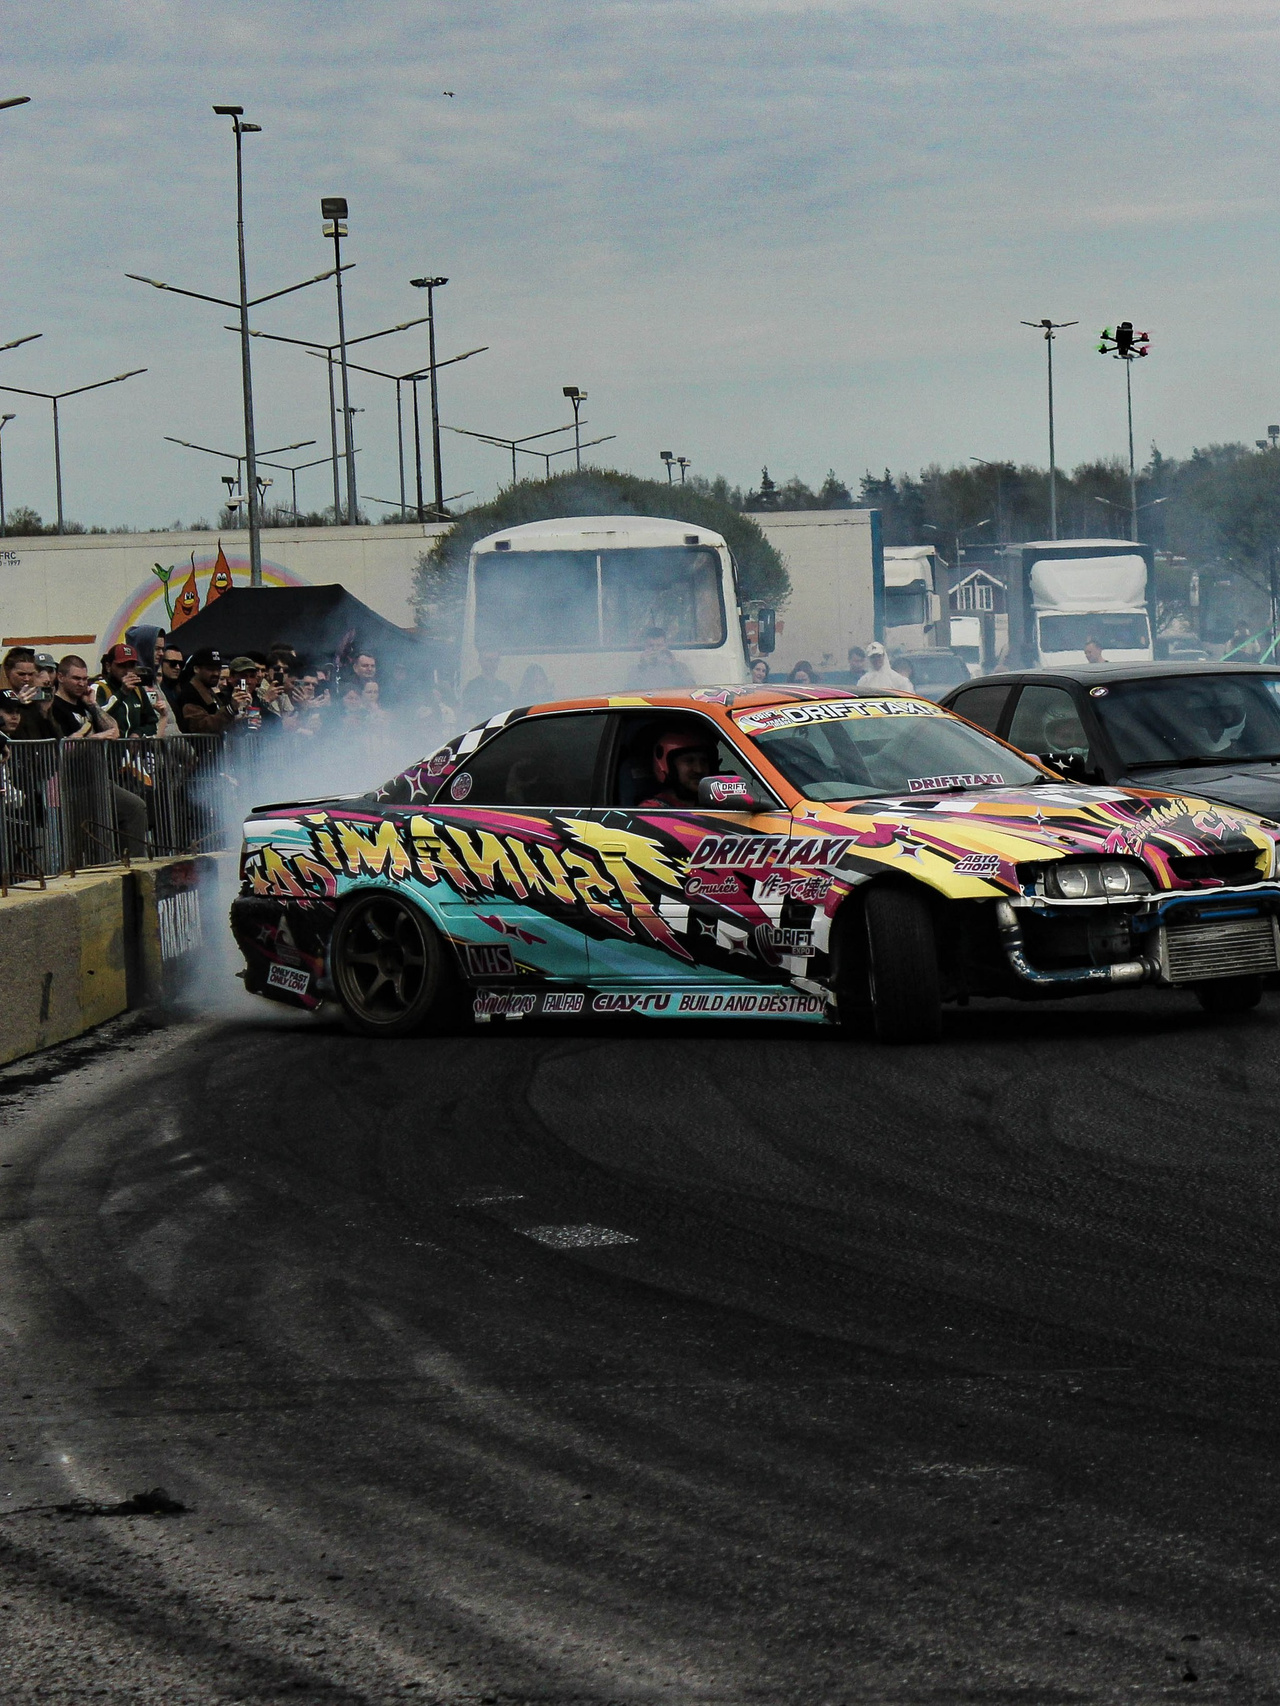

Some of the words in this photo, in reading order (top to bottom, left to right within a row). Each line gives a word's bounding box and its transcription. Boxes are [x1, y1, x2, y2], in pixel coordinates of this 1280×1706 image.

[781, 700, 870, 724] DRIFT
[868, 700, 929, 719] TAXI
[908, 777, 959, 793] DRIFT
[957, 774, 1004, 787] TAXI
[690, 838, 780, 865] DRIFT
[775, 838, 854, 865] TAXI
[962, 855, 999, 863] АВТО
[954, 863, 998, 871] СПОРТ
[774, 929, 814, 946] DRIFT
[792, 947, 810, 955] EXPO
[470, 947, 513, 973] VHS
[270, 974, 288, 984] ONLY
[287, 980, 306, 991] LOW
[271, 965, 290, 977] ONLY
[289, 971, 308, 983] FAST
[679, 995, 723, 1011] BUILD
[723, 995, 759, 1011] AND
[757, 996, 826, 1012] DESTROY
